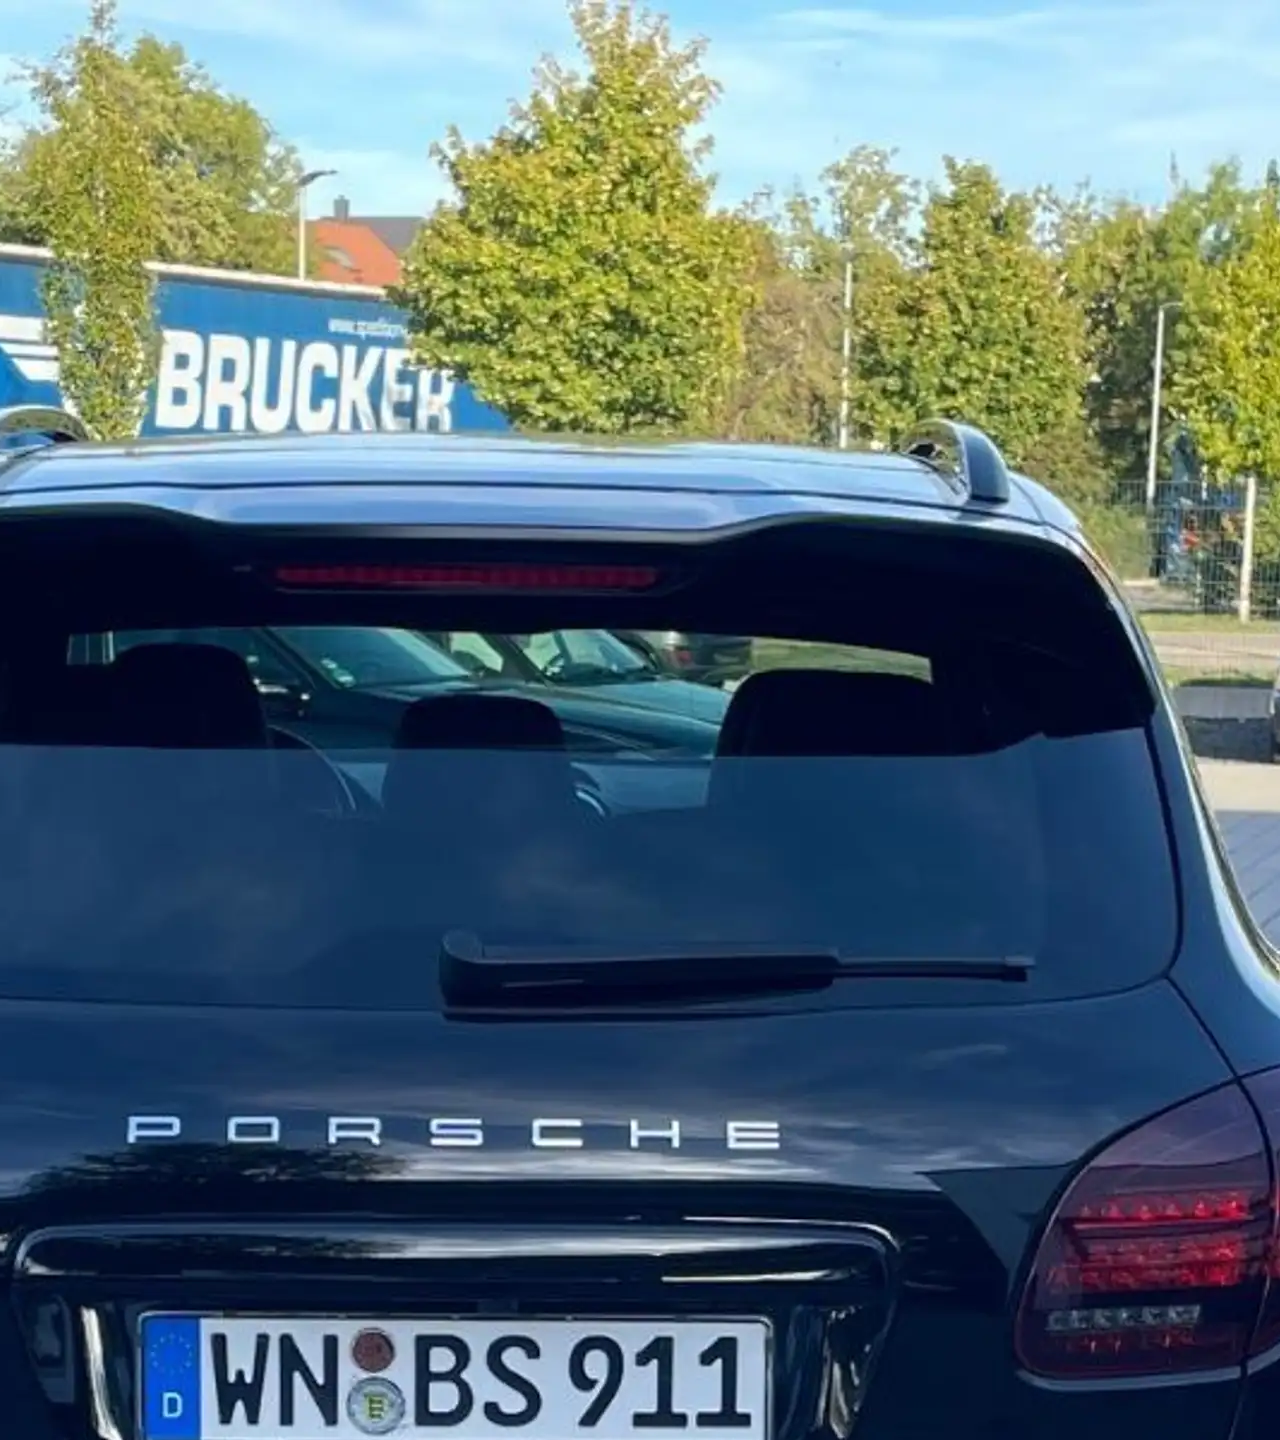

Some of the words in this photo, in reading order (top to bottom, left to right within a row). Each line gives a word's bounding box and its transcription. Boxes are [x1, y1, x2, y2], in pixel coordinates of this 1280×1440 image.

[154, 329, 456, 433] BRUCKER
[127, 1116, 781, 1149] PORSCHE
[162, 1391, 183, 1419] D
[210, 1333, 339, 1427] WN
[414, 1333, 542, 1428] BS
[568, 1334, 752, 1428] 911
